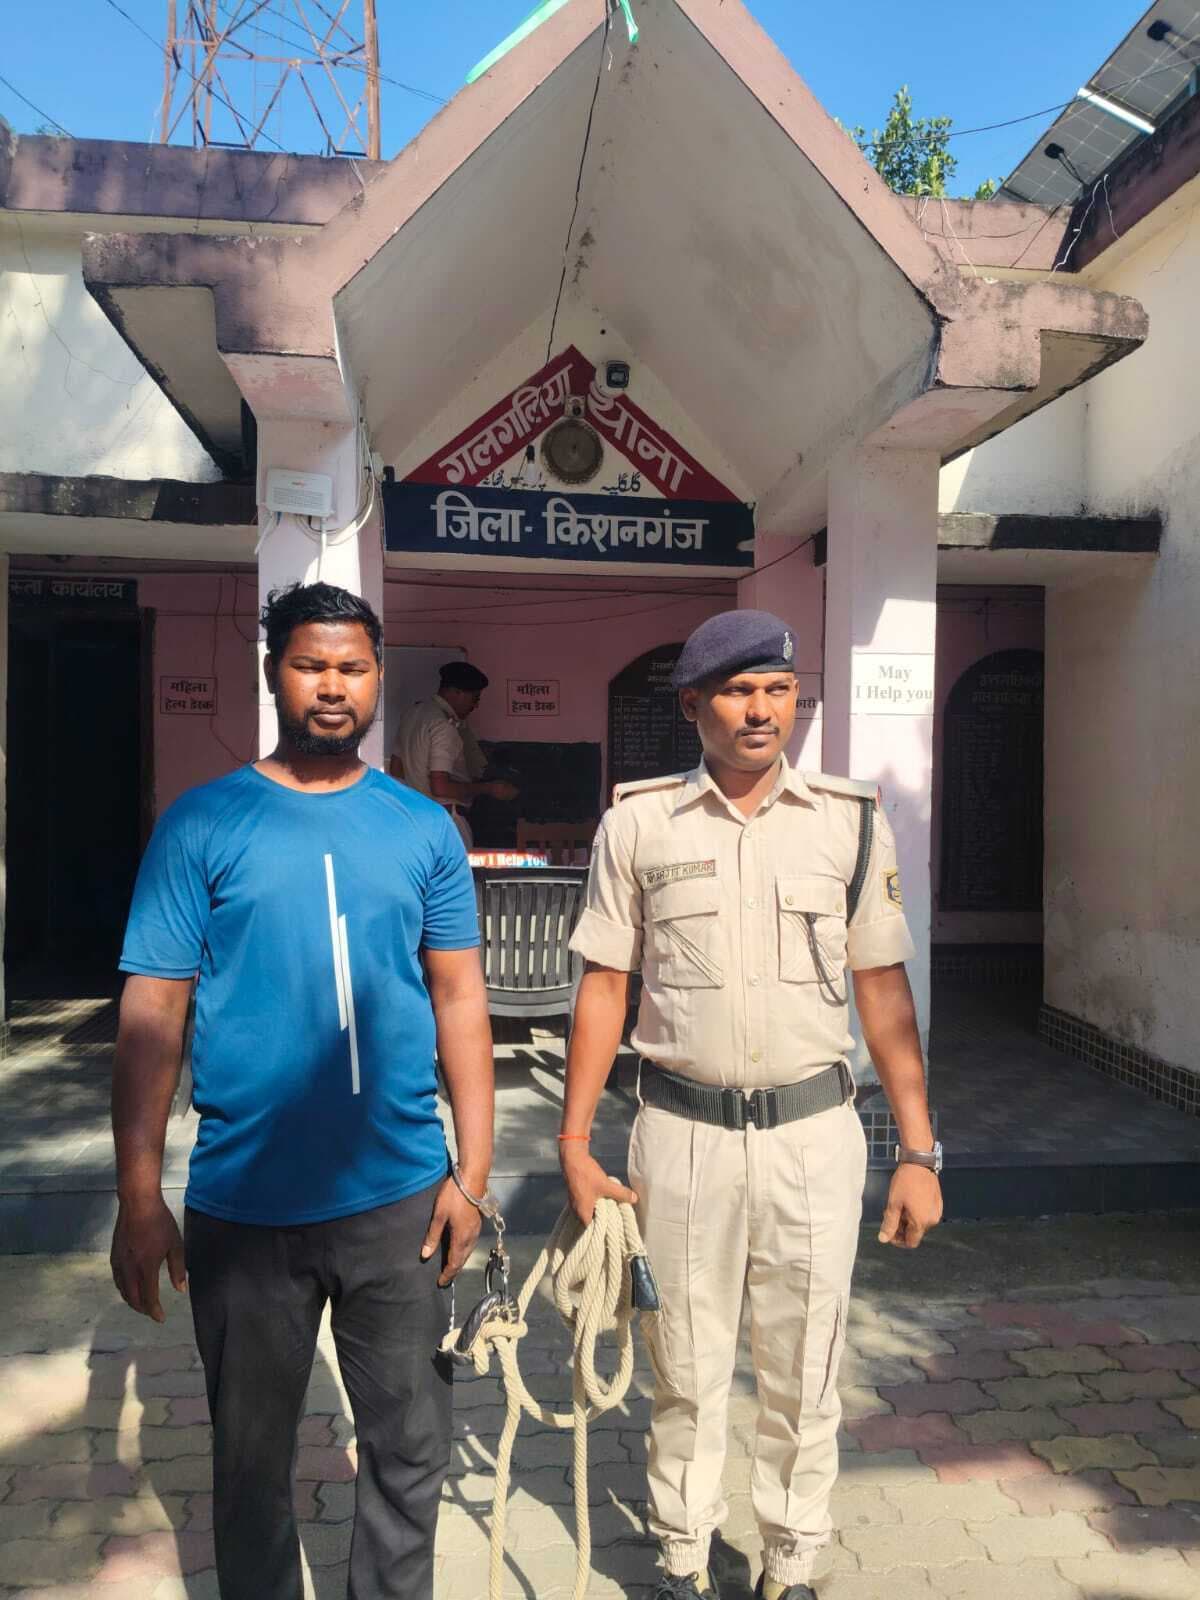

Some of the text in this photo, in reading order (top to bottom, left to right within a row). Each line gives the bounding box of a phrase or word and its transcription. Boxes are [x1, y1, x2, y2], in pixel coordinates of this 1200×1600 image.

[438, 363, 574, 484] गलगलिया
[542, 498, 709, 552] किशनगंज
[50, 577, 126, 599] कार्यालय
[879, 664, 912, 682] May
[170, 680, 208, 695] महिला
[516, 683, 550, 696] महिला
[856, 685, 933, 702] I Help you
[497, 853, 525, 867] Help
[527, 853, 548, 866] You
